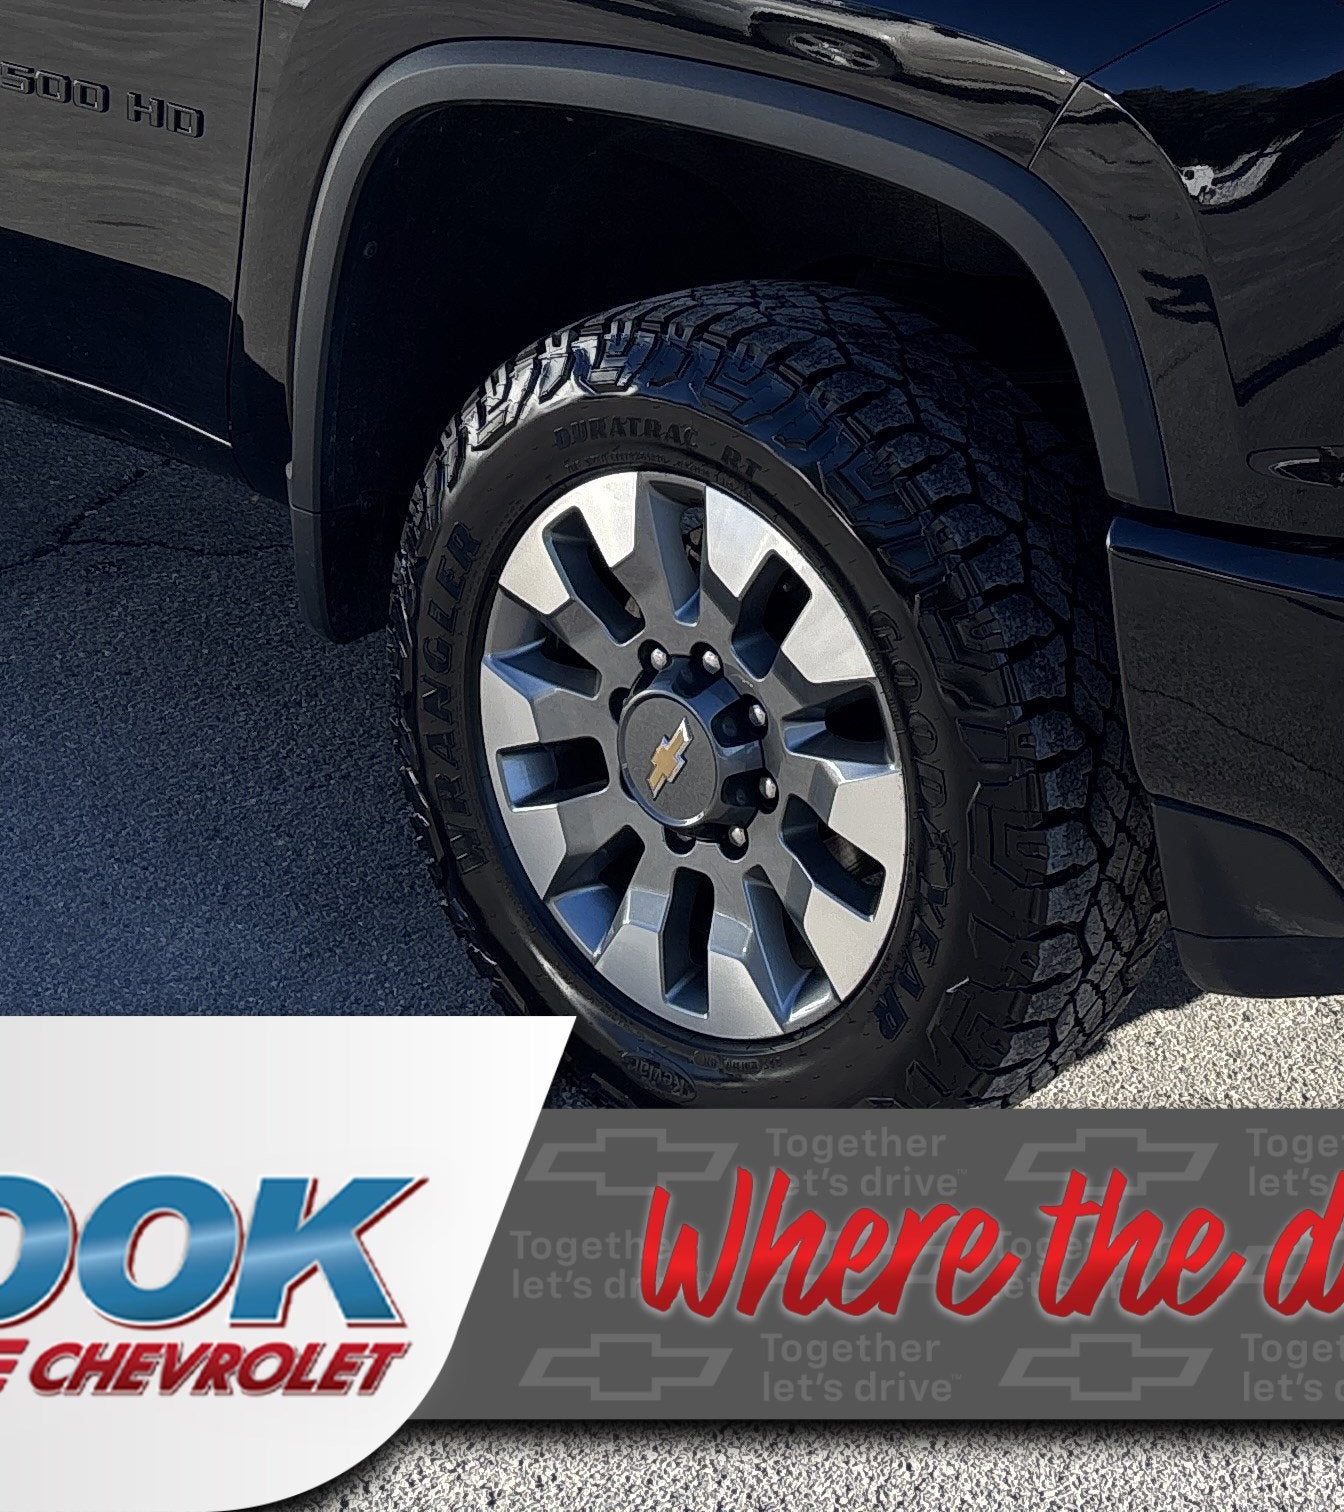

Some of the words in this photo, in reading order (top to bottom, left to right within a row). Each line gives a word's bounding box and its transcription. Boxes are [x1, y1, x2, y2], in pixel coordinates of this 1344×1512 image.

[126, 91, 205, 138] HD
[552, 415, 700, 450] DURATRAC
[421, 521, 490, 875] WRANGLER
[867, 609, 954, 1042] GOODYEAR
